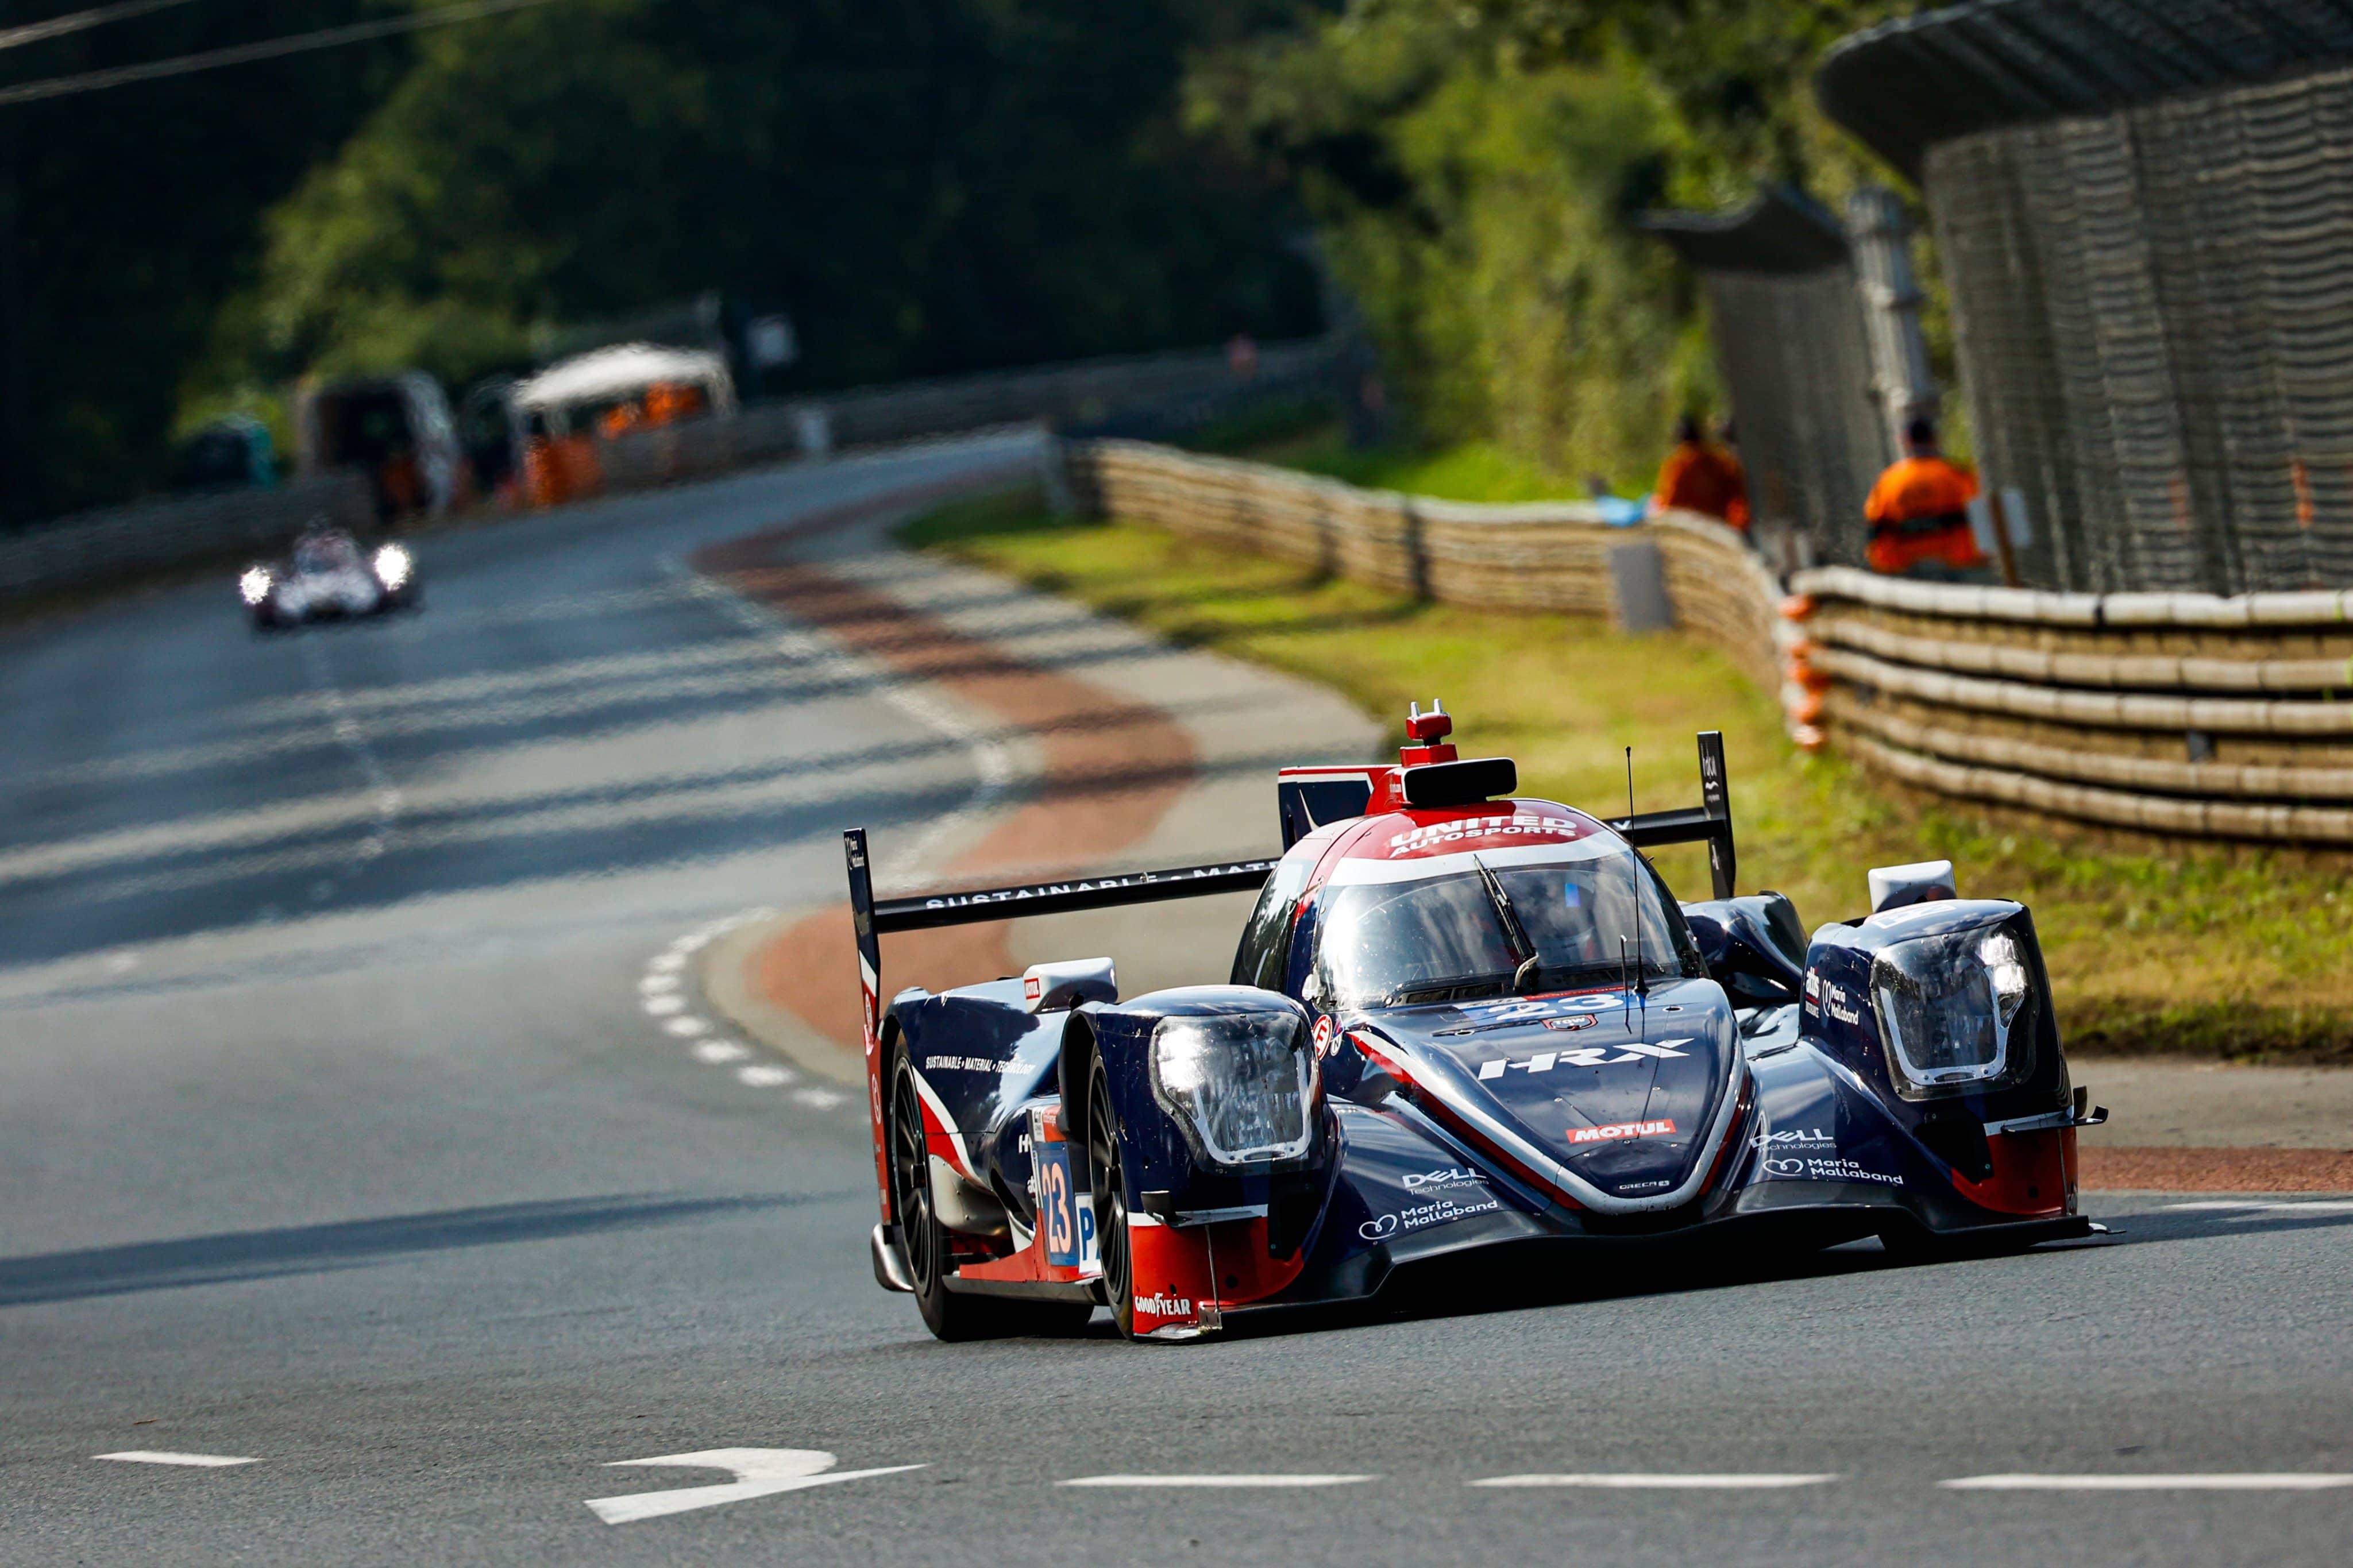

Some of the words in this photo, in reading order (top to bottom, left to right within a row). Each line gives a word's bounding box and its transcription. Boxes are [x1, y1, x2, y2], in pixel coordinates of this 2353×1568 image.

[1391, 816, 1577, 847] UNITED
[1388, 827, 1576, 859] AUTOSPORTS
[1831, 984, 1846, 1003] Maria
[1488, 994, 1624, 1021] 23
[1831, 1002, 1859, 1025] Mallaband
[1556, 1017, 1587, 1025] TOW
[925, 1056, 962, 1069] SUSTAINABLE
[964, 1057, 993, 1072] MATERIAL
[995, 1060, 1036, 1075] TECHNOLOGY
[1478, 1038, 1695, 1080] HRX
[1574, 1122, 1671, 1141] MOTUL
[1749, 1128, 1834, 1148] DELL
[1807, 1158, 1860, 1169] Maria
[1402, 1167, 1487, 1189] DELL
[1811, 1167, 1904, 1185] Mallaband
[1410, 1178, 1490, 1196] Technologies
[1042, 1162, 1072, 1254] 23
[1401, 1200, 1454, 1220] Maria
[1404, 1200, 1499, 1229] Mallaband
[1135, 1292, 1191, 1318] GOODYEAR
